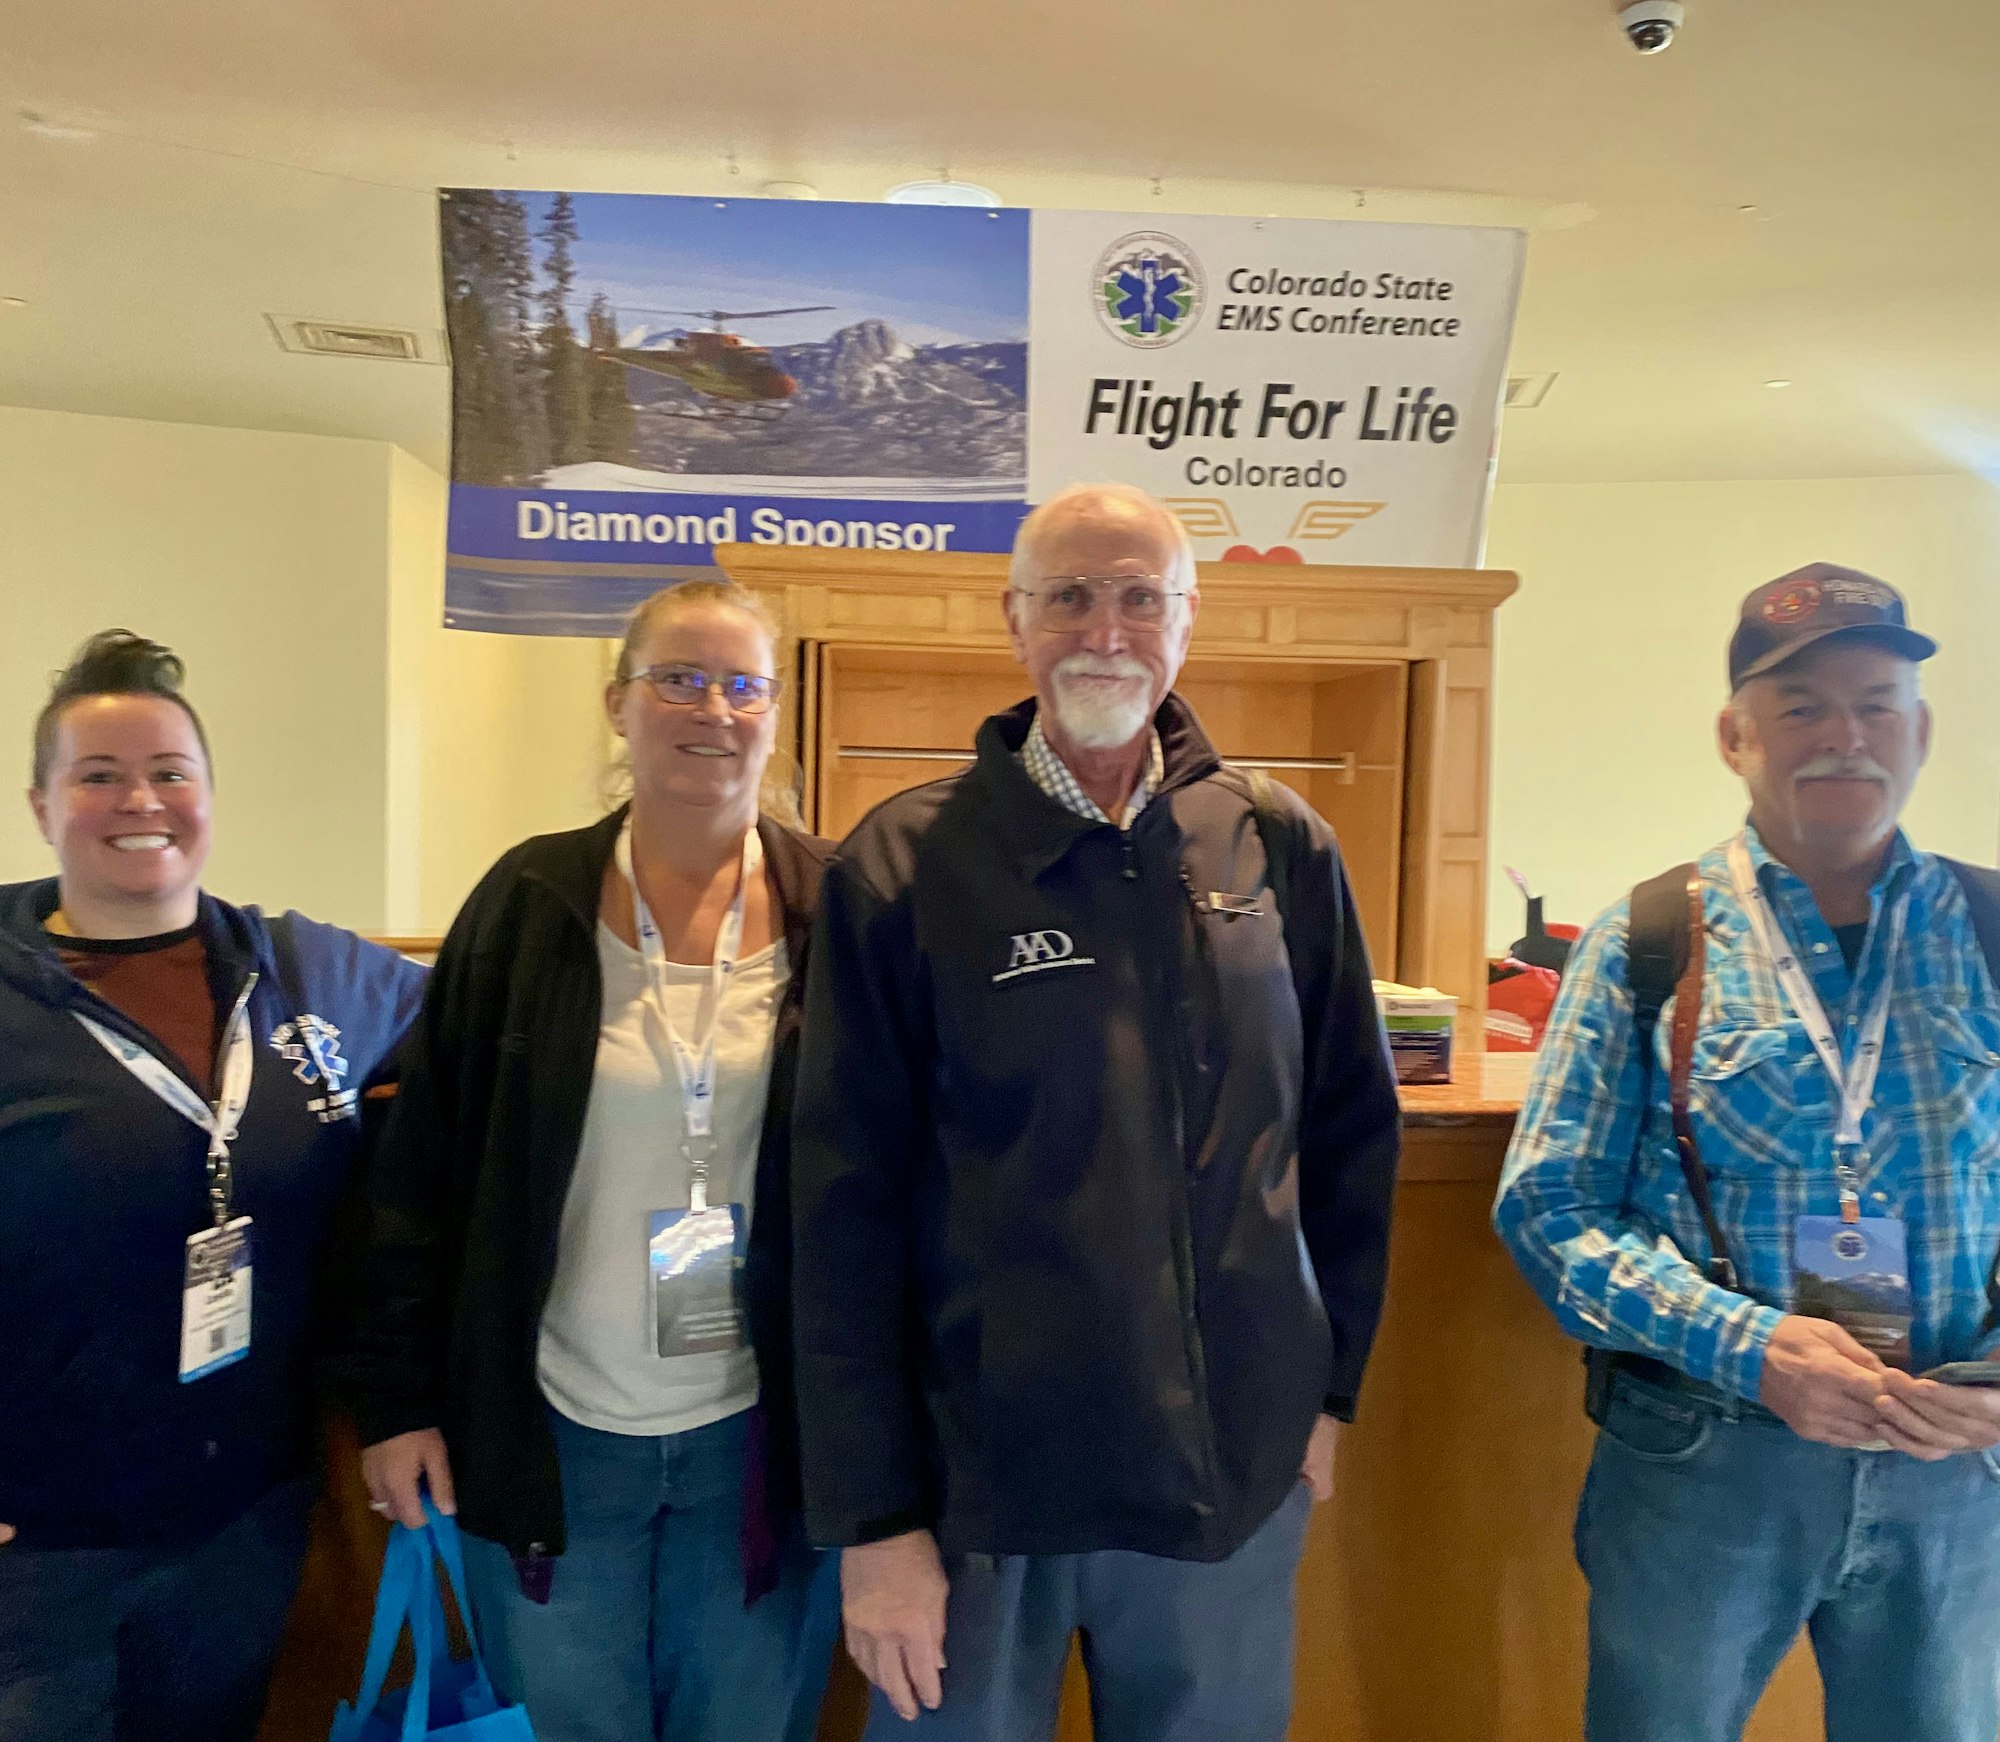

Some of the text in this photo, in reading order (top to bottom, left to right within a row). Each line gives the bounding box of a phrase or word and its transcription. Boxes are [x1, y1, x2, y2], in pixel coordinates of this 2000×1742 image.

[1228, 268, 1454, 301] Colorado State
[1217, 304, 1460, 337] EMS Conference
[1085, 378, 1458, 450] Flight For Life
[1186, 456, 1347, 489] Colorado
[517, 500, 956, 551] Diamond Sponsor
